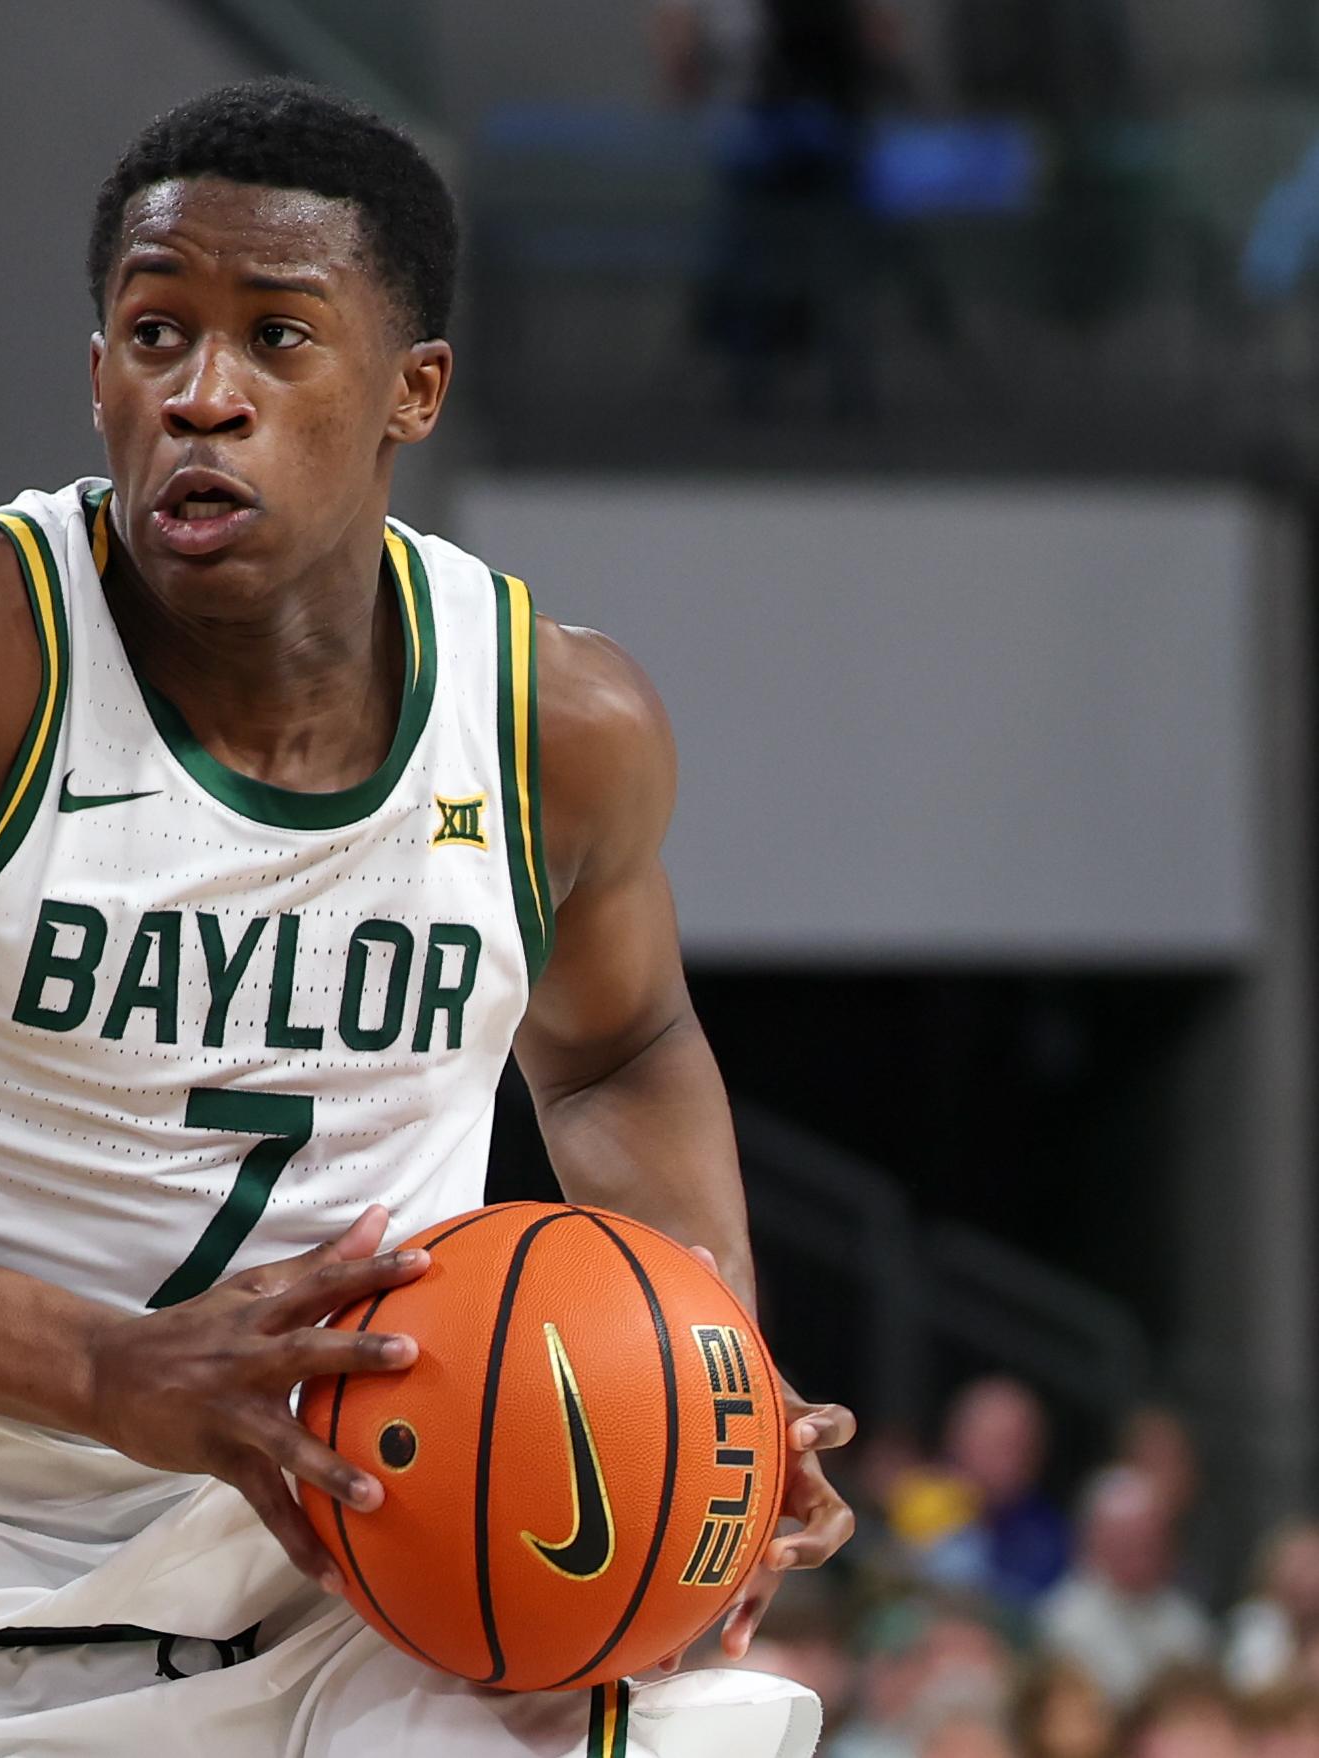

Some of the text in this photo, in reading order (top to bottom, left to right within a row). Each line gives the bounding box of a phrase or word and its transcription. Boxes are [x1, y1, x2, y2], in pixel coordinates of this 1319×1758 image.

[433, 797, 486, 845] XII
[11, 898, 482, 1053] BAYLOR
[145, 1086, 315, 1310] 7
[678, 1324, 756, 1586] ELITE
